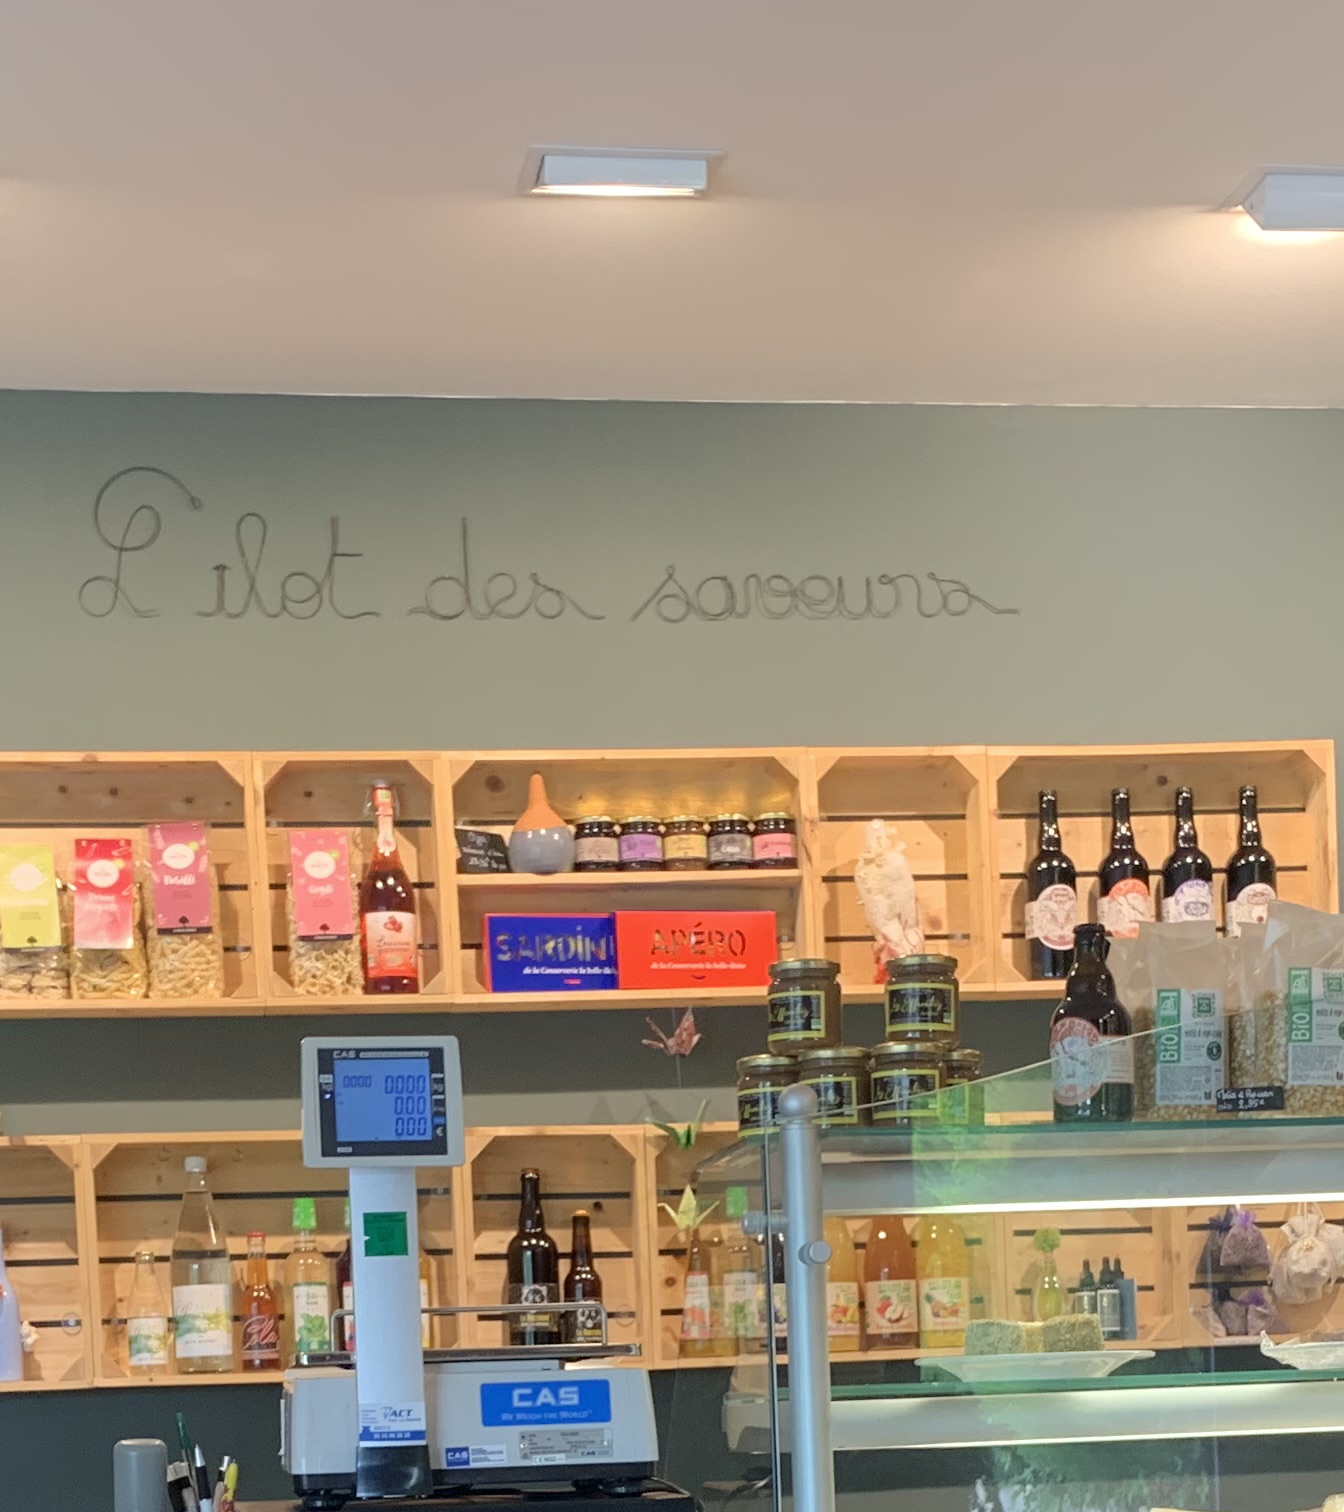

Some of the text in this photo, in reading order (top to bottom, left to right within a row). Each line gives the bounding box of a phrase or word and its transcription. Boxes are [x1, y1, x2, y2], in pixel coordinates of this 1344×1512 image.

[408, 517, 606, 622] des
[631, 563, 1020, 623] saveurs
[650, 921, 746, 956] APÉRO
[333, 1051, 356, 1059] CAS
[512, 1386, 580, 1408] CAS
